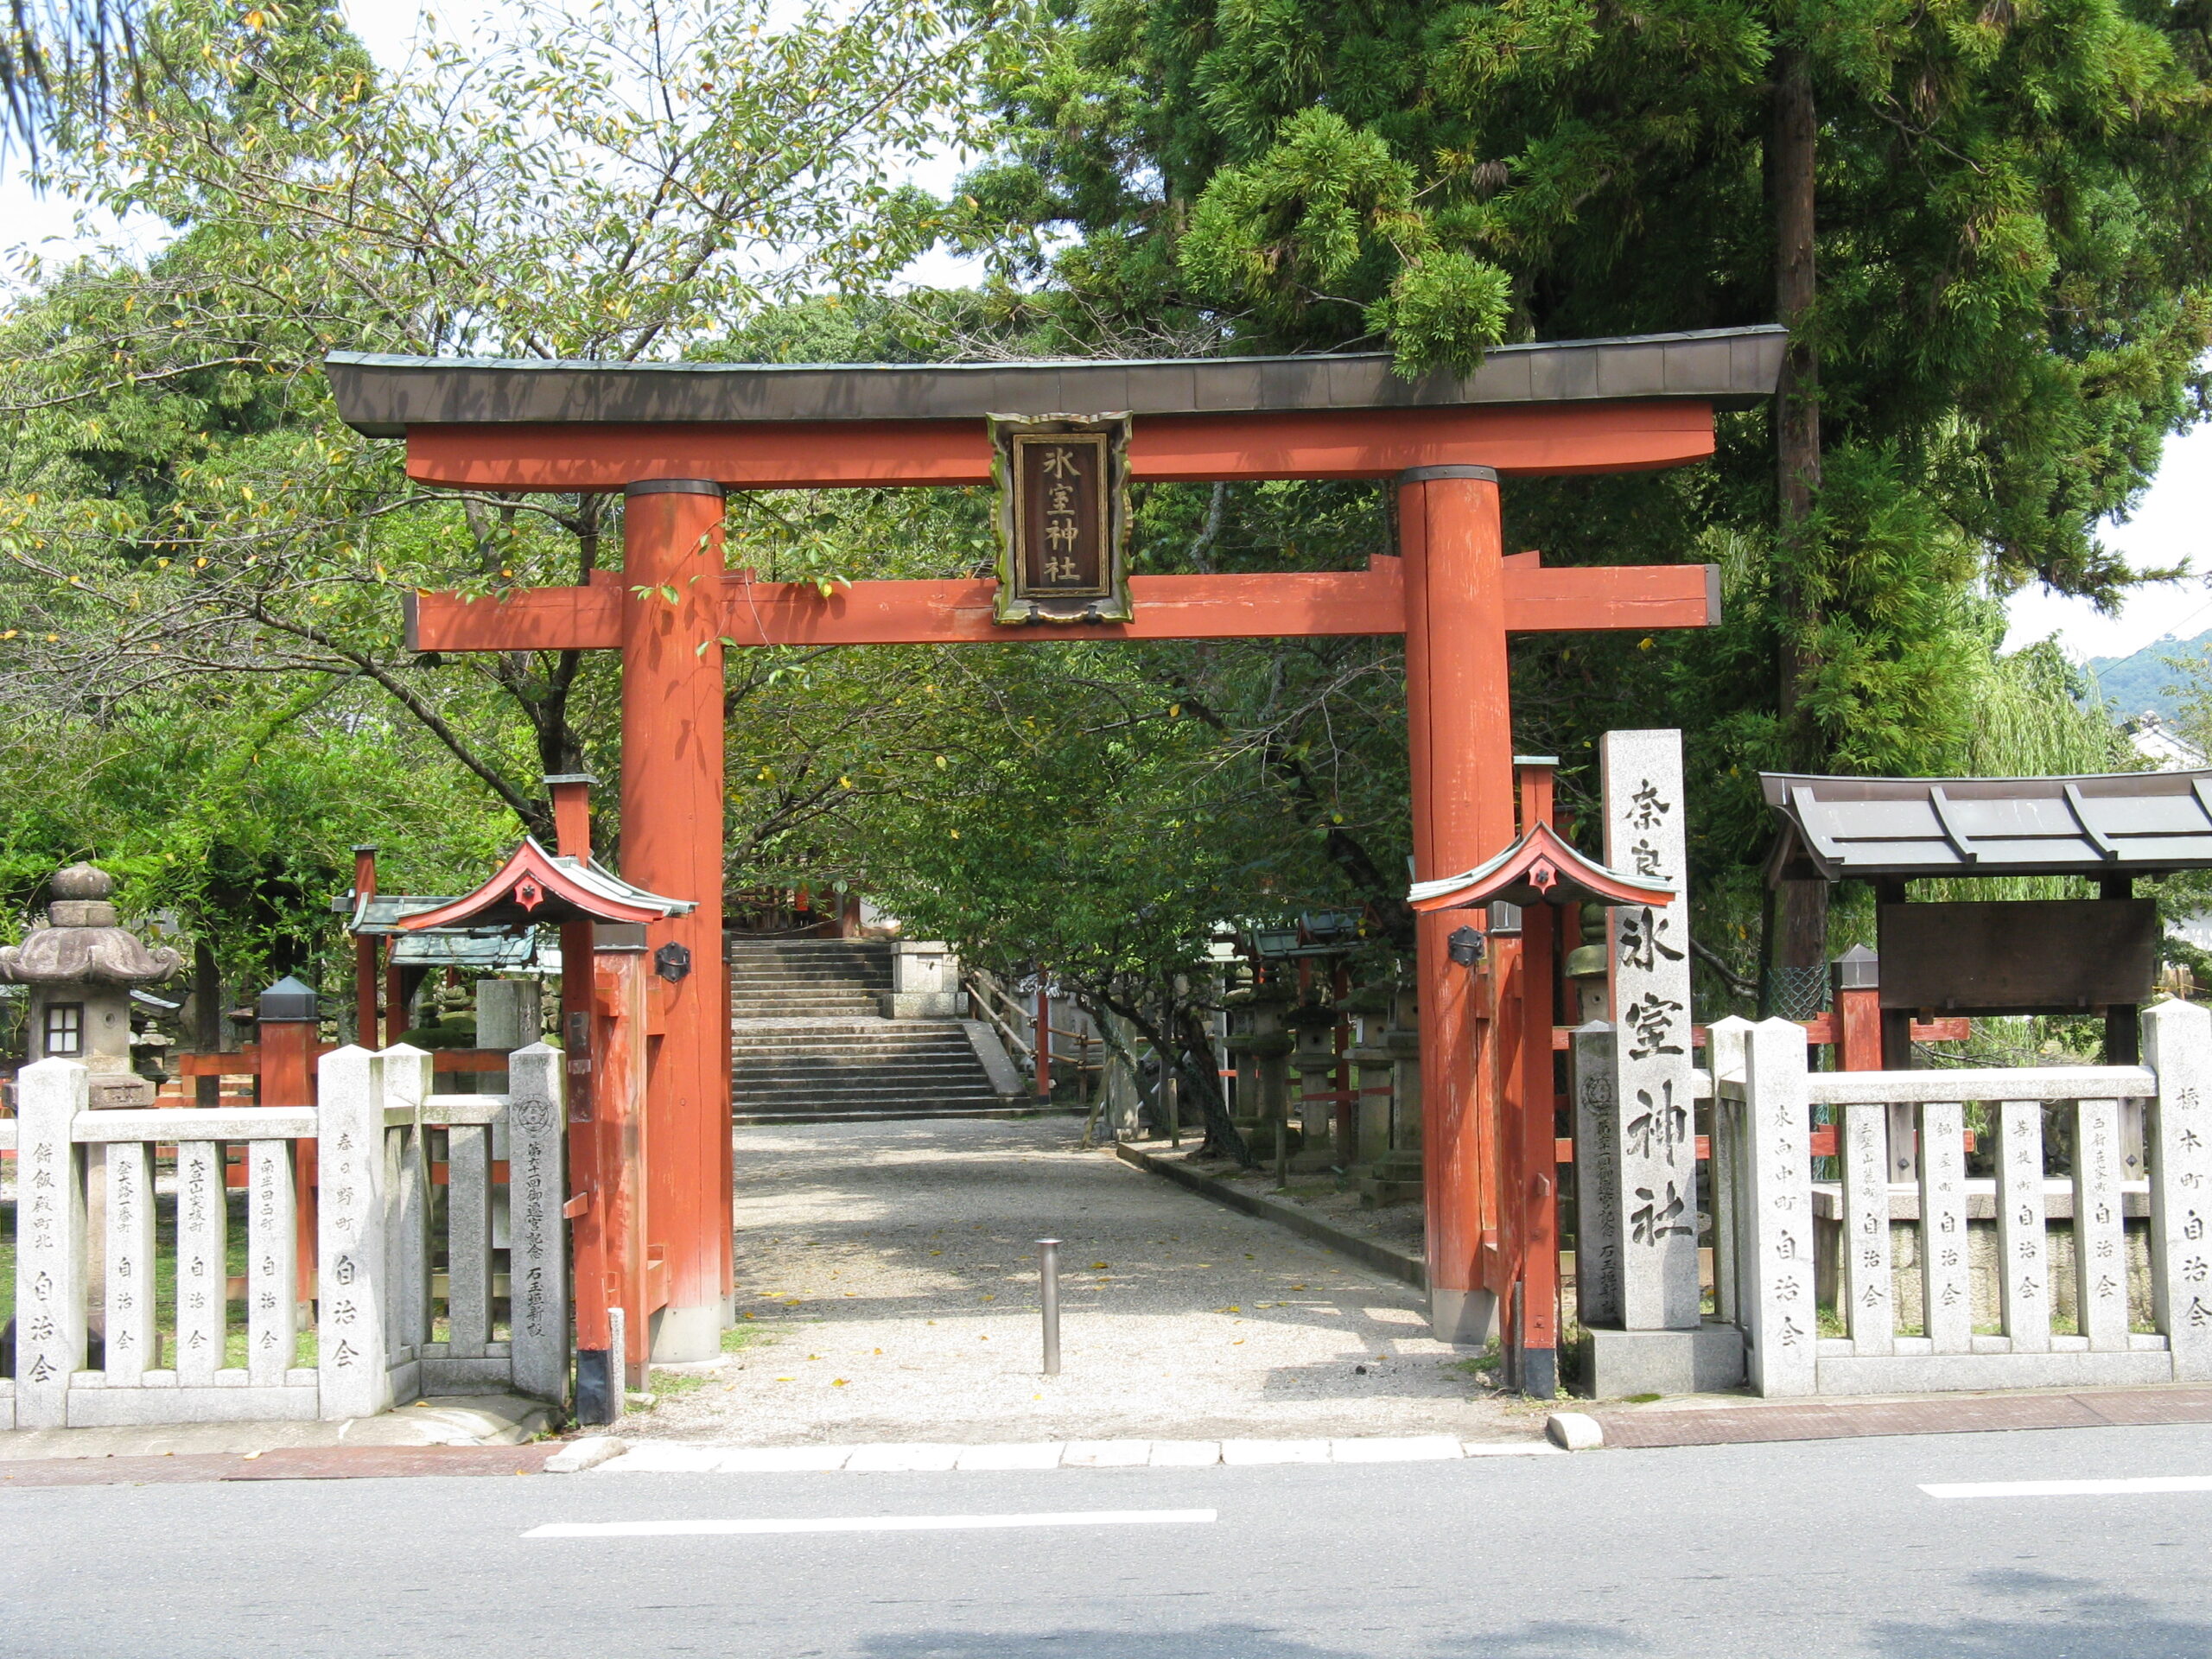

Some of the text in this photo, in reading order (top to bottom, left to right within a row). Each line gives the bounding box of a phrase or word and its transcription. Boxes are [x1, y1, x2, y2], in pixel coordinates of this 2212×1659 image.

[1042, 447, 1081, 582] 氷室神社
[1620, 779, 1693, 1247] 奈良氷室神社
